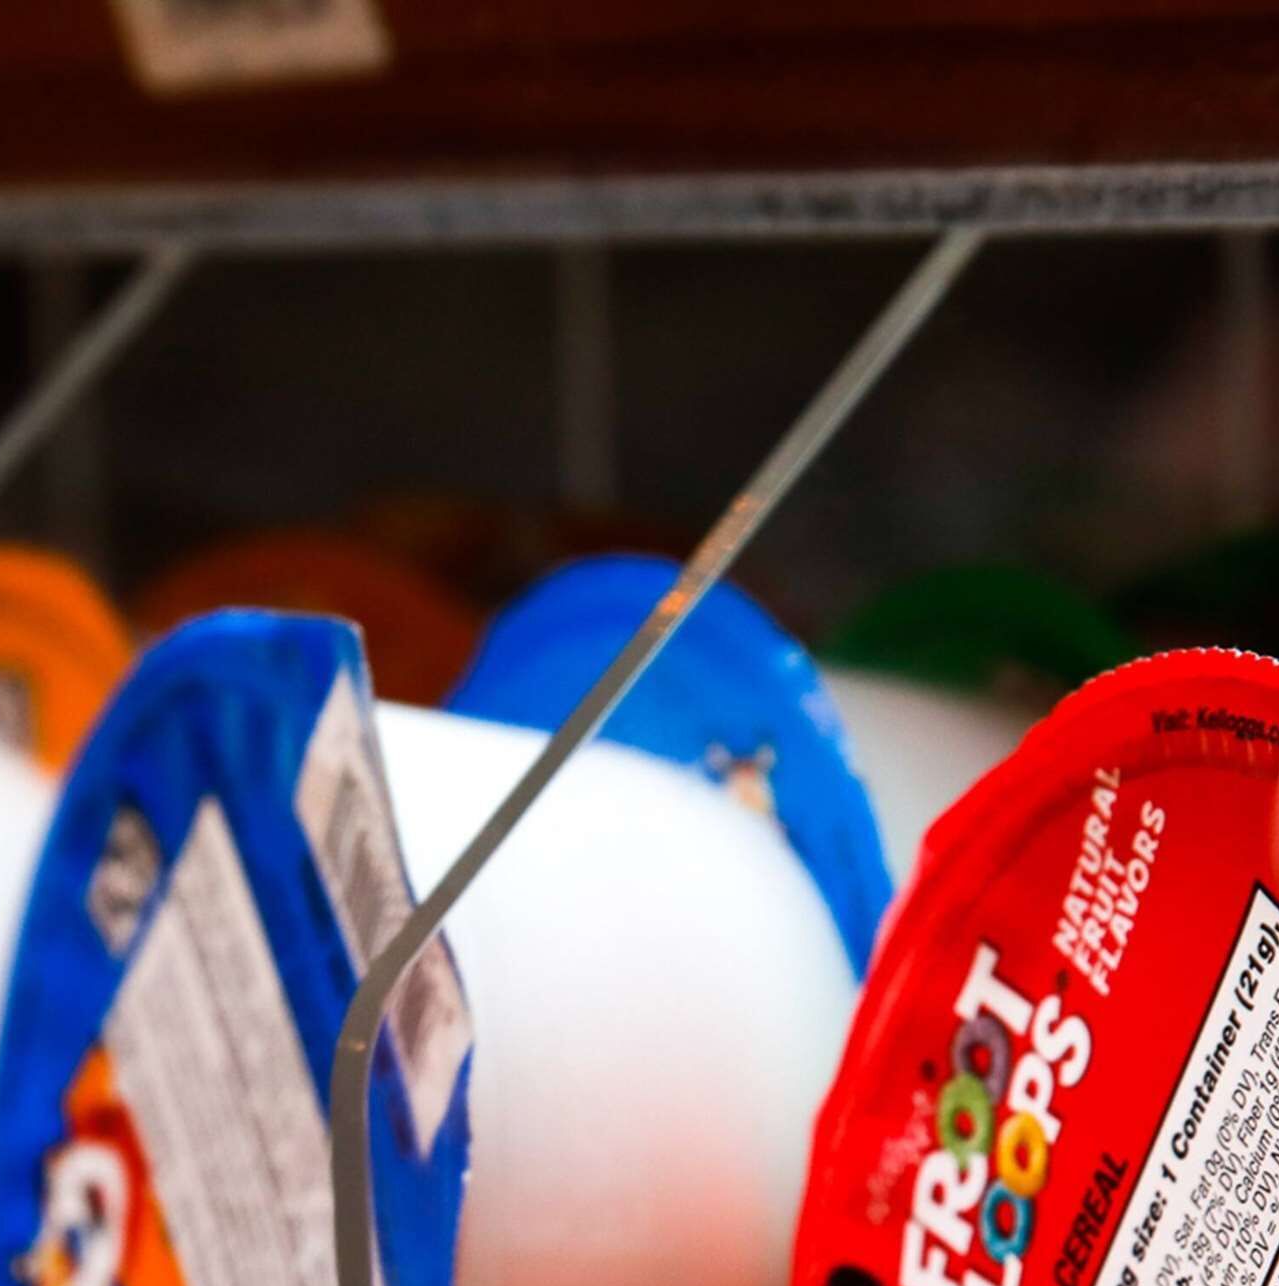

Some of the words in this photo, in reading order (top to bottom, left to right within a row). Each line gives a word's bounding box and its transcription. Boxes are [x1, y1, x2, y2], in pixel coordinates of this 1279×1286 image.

[1052, 767, 1120, 956] NATURAL
[1073, 847, 1126, 976] FRUIT
[1089, 799, 1166, 997] FLAVORS
[1131, 1190, 1168, 1263] size:
[1161, 1163, 1177, 1184] 1
[1170, 1009, 1242, 1161] Container
[1173, 1213, 1198, 1250] Sat.
[1189, 1174, 1213, 1211] Fat
[1204, 1149, 1226, 1177] 0g
[1215, 1111, 1240, 1152] (0%
[1231, 1068, 1260, 1111] DV),
[1187, 1231, 1212, 1267] 18g
[1217, 1151, 1246, 1193] DV),
[1236, 1095, 1265, 1149] Fiber
[1259, 1069, 1279, 1095] 1g
[1214, 1208, 1243, 1250] DV),
[1234, 1128, 1274, 1205] Calcium
[1231, 1212, 1260, 1265] (10%
[1251, 1170, 1279, 1213] DV),
[1248, 1231, 1270, 1270] DV
